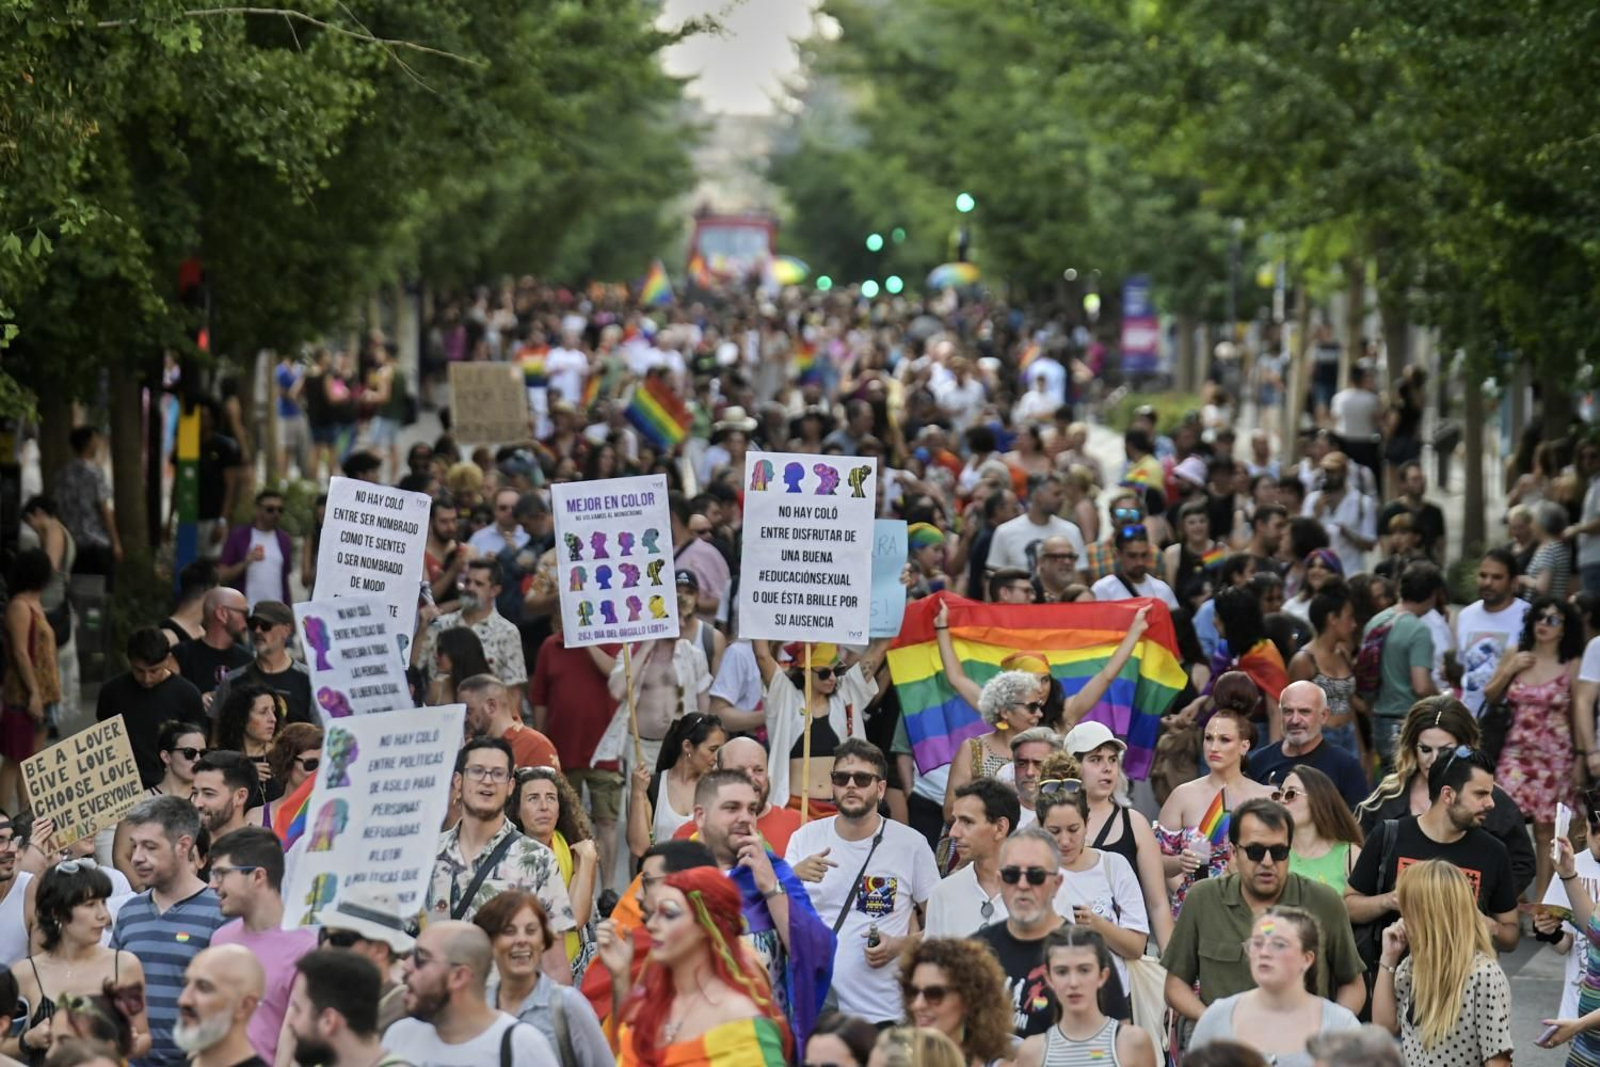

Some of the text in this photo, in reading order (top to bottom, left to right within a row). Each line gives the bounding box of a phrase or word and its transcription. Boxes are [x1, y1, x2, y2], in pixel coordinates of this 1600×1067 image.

[356, 490, 403, 510] NO HAY COLÓ
[567, 492, 655, 512] MEJOR EN COLOR
[779, 505, 838, 519] NO HAY COLÓ
[334, 508, 418, 535] ENTRE SER NOMBRADO
[340, 530, 406, 554] COMO TE SIENTES
[761, 527, 856, 542] ENTRE DISFRUTAR DE
[338, 552, 403, 575] O SER NOMBRADO
[781, 549, 833, 563] UNA BUENA
[350, 576, 385, 592] DE MODO
[759, 569, 851, 586] #EDUCACIÓNSEXUAL
[753, 590, 858, 607] O QUE ÉSTA BRILLE POR
[338, 609, 346, 620] NO
[775, 614, 834, 628] SU AUSENCIA
[334, 628, 350, 640] ENTRE
[606, 629, 617, 638] DEL
[619, 626, 646, 637] ORGULLO
[379, 734, 392, 747] NO
[394, 733, 412, 746] HAY
[25, 722, 121, 779] BE A LOVER
[368, 756, 396, 772] ENTRE
[29, 766, 69, 797] GIVE
[34, 758, 134, 818] CHOOSE LOVE
[369, 776, 436, 794] DE ASILO PARA
[371, 800, 420, 816] PERSONAS
[51, 809, 76, 833] OVE
[363, 822, 420, 839] REFUGIADAS
[401, 868, 420, 881] QUE
